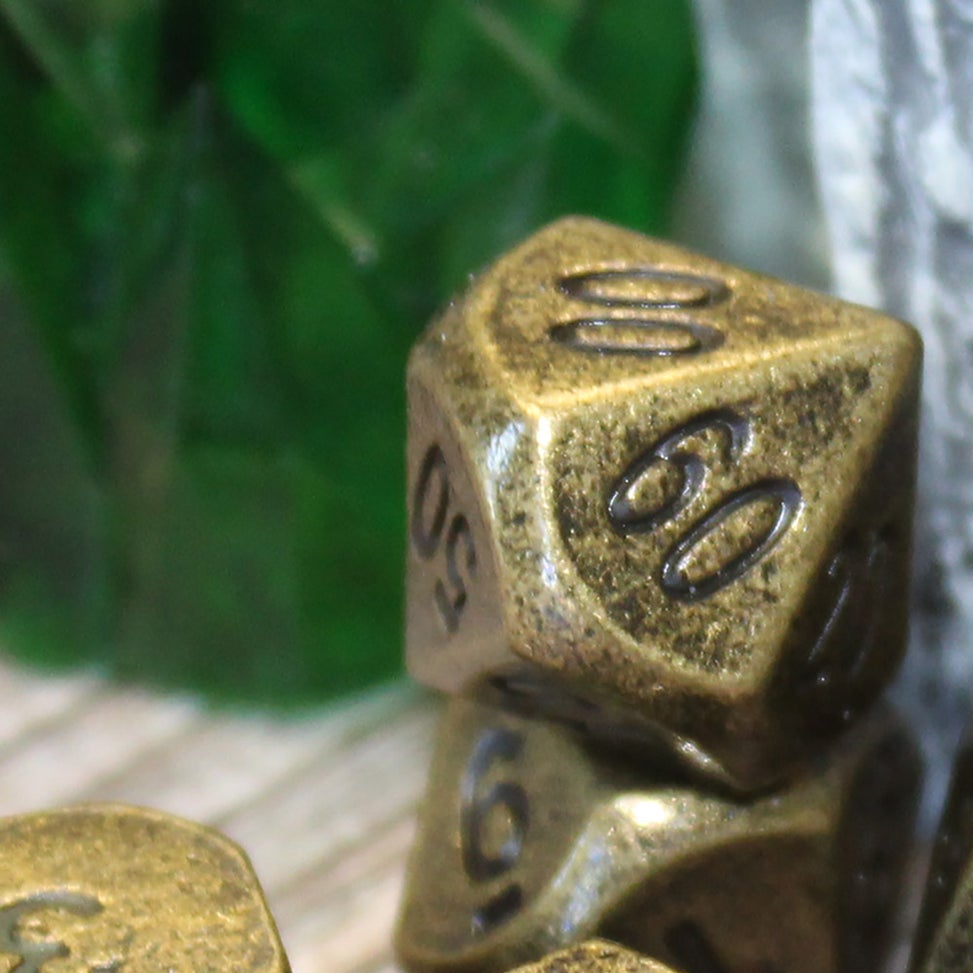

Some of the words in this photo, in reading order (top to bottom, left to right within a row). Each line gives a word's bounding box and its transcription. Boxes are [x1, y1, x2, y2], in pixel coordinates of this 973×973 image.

[549, 267, 732, 356] 00
[411, 442, 478, 634] 50
[607, 408, 802, 602] 60
